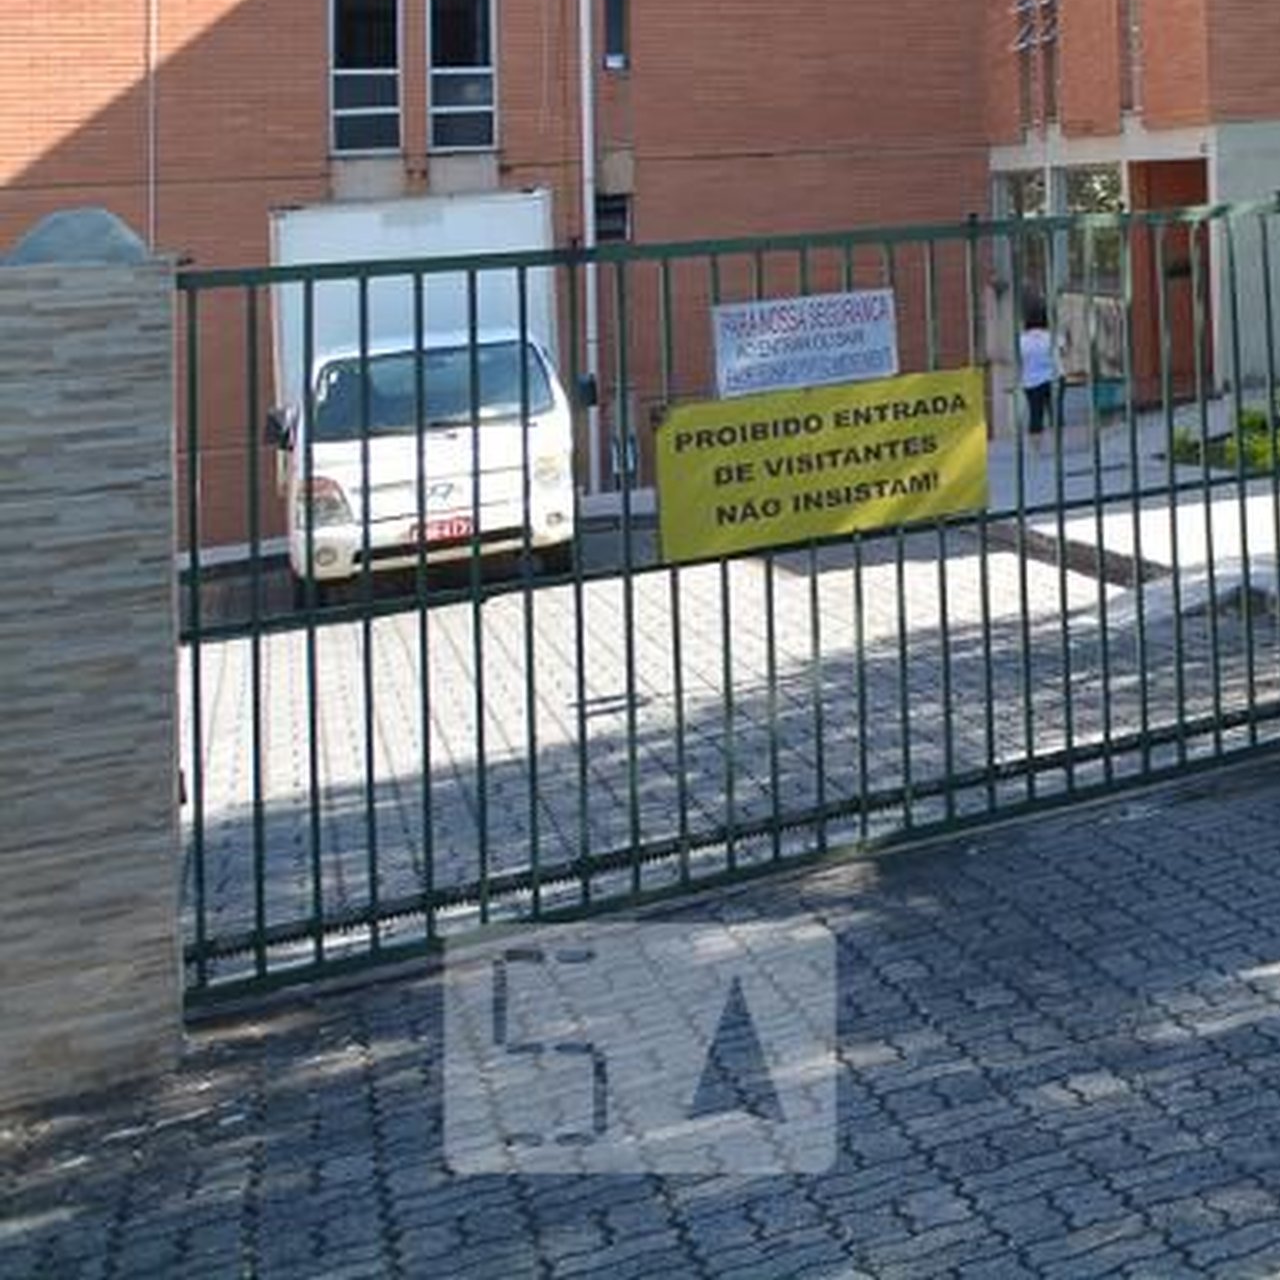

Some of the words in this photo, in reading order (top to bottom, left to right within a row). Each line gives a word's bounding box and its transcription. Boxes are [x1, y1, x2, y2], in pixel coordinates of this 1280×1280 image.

[674, 415, 824, 453] PROIBIDO
[833, 394, 968, 428] ENTRADA
[714, 462, 755, 487] DE
[763, 434, 939, 478] VISITANTES
[792, 471, 940, 513] INSISTAM!
